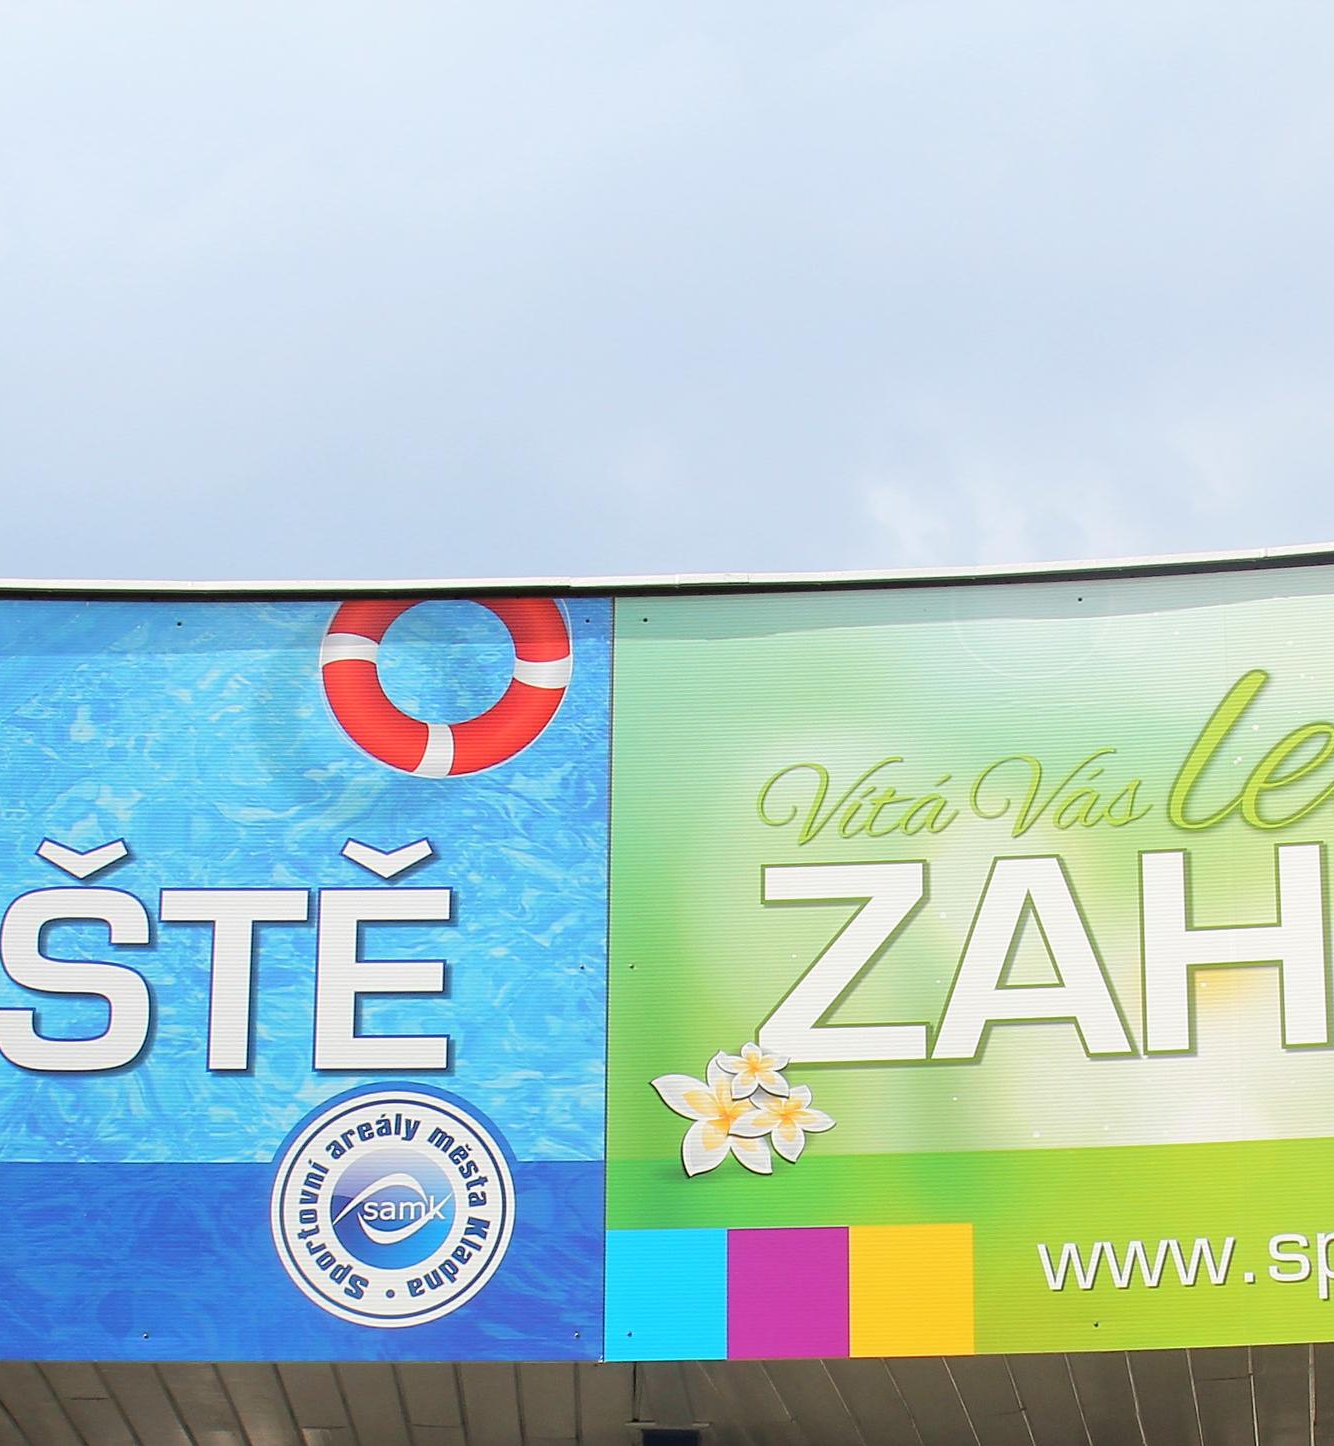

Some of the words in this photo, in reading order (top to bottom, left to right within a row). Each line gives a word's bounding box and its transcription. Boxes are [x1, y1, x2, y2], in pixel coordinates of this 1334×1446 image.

[757, 757, 958, 847] Vítá
[969, 748, 1154, 837] Vás
[326, 1113, 421, 1160] areály
[427, 1126, 488, 1207] města
[298, 1160, 369, 1300] Sportovní
[363, 1196, 446, 1221] samk
[407, 1216, 491, 1298] Kladna
